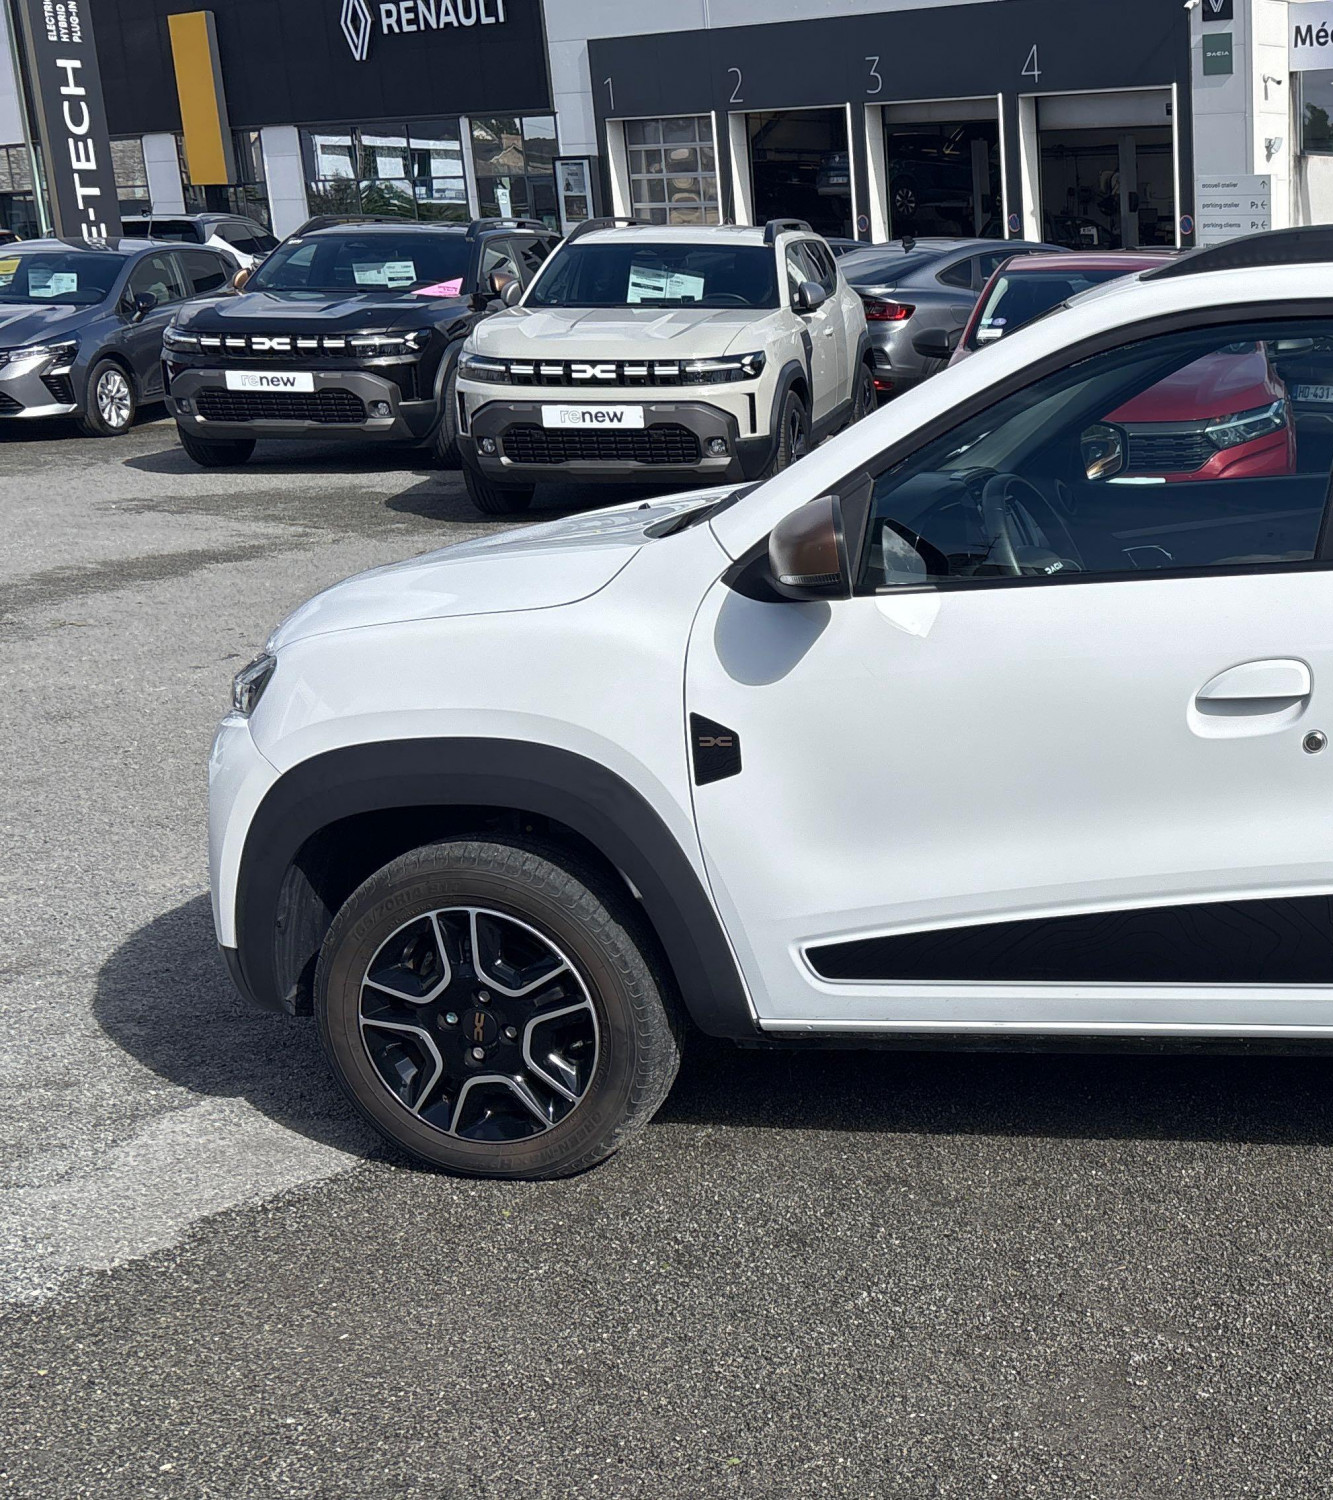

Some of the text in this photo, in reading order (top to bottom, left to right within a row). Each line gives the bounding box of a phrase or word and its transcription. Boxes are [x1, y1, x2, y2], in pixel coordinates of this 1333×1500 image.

[43, 0, 58, 41] ELECTRI
[56, 4, 70, 42] HYBRID
[67, 1, 83, 43] PLUG-IN
[865, 56, 883, 94] 3
[1020, 44, 1042, 83] 4
[603, 77, 615, 110] 1
[727, 67, 744, 103] 2
[241, 375, 296, 387] renew
[560, 410, 624, 424] renew
